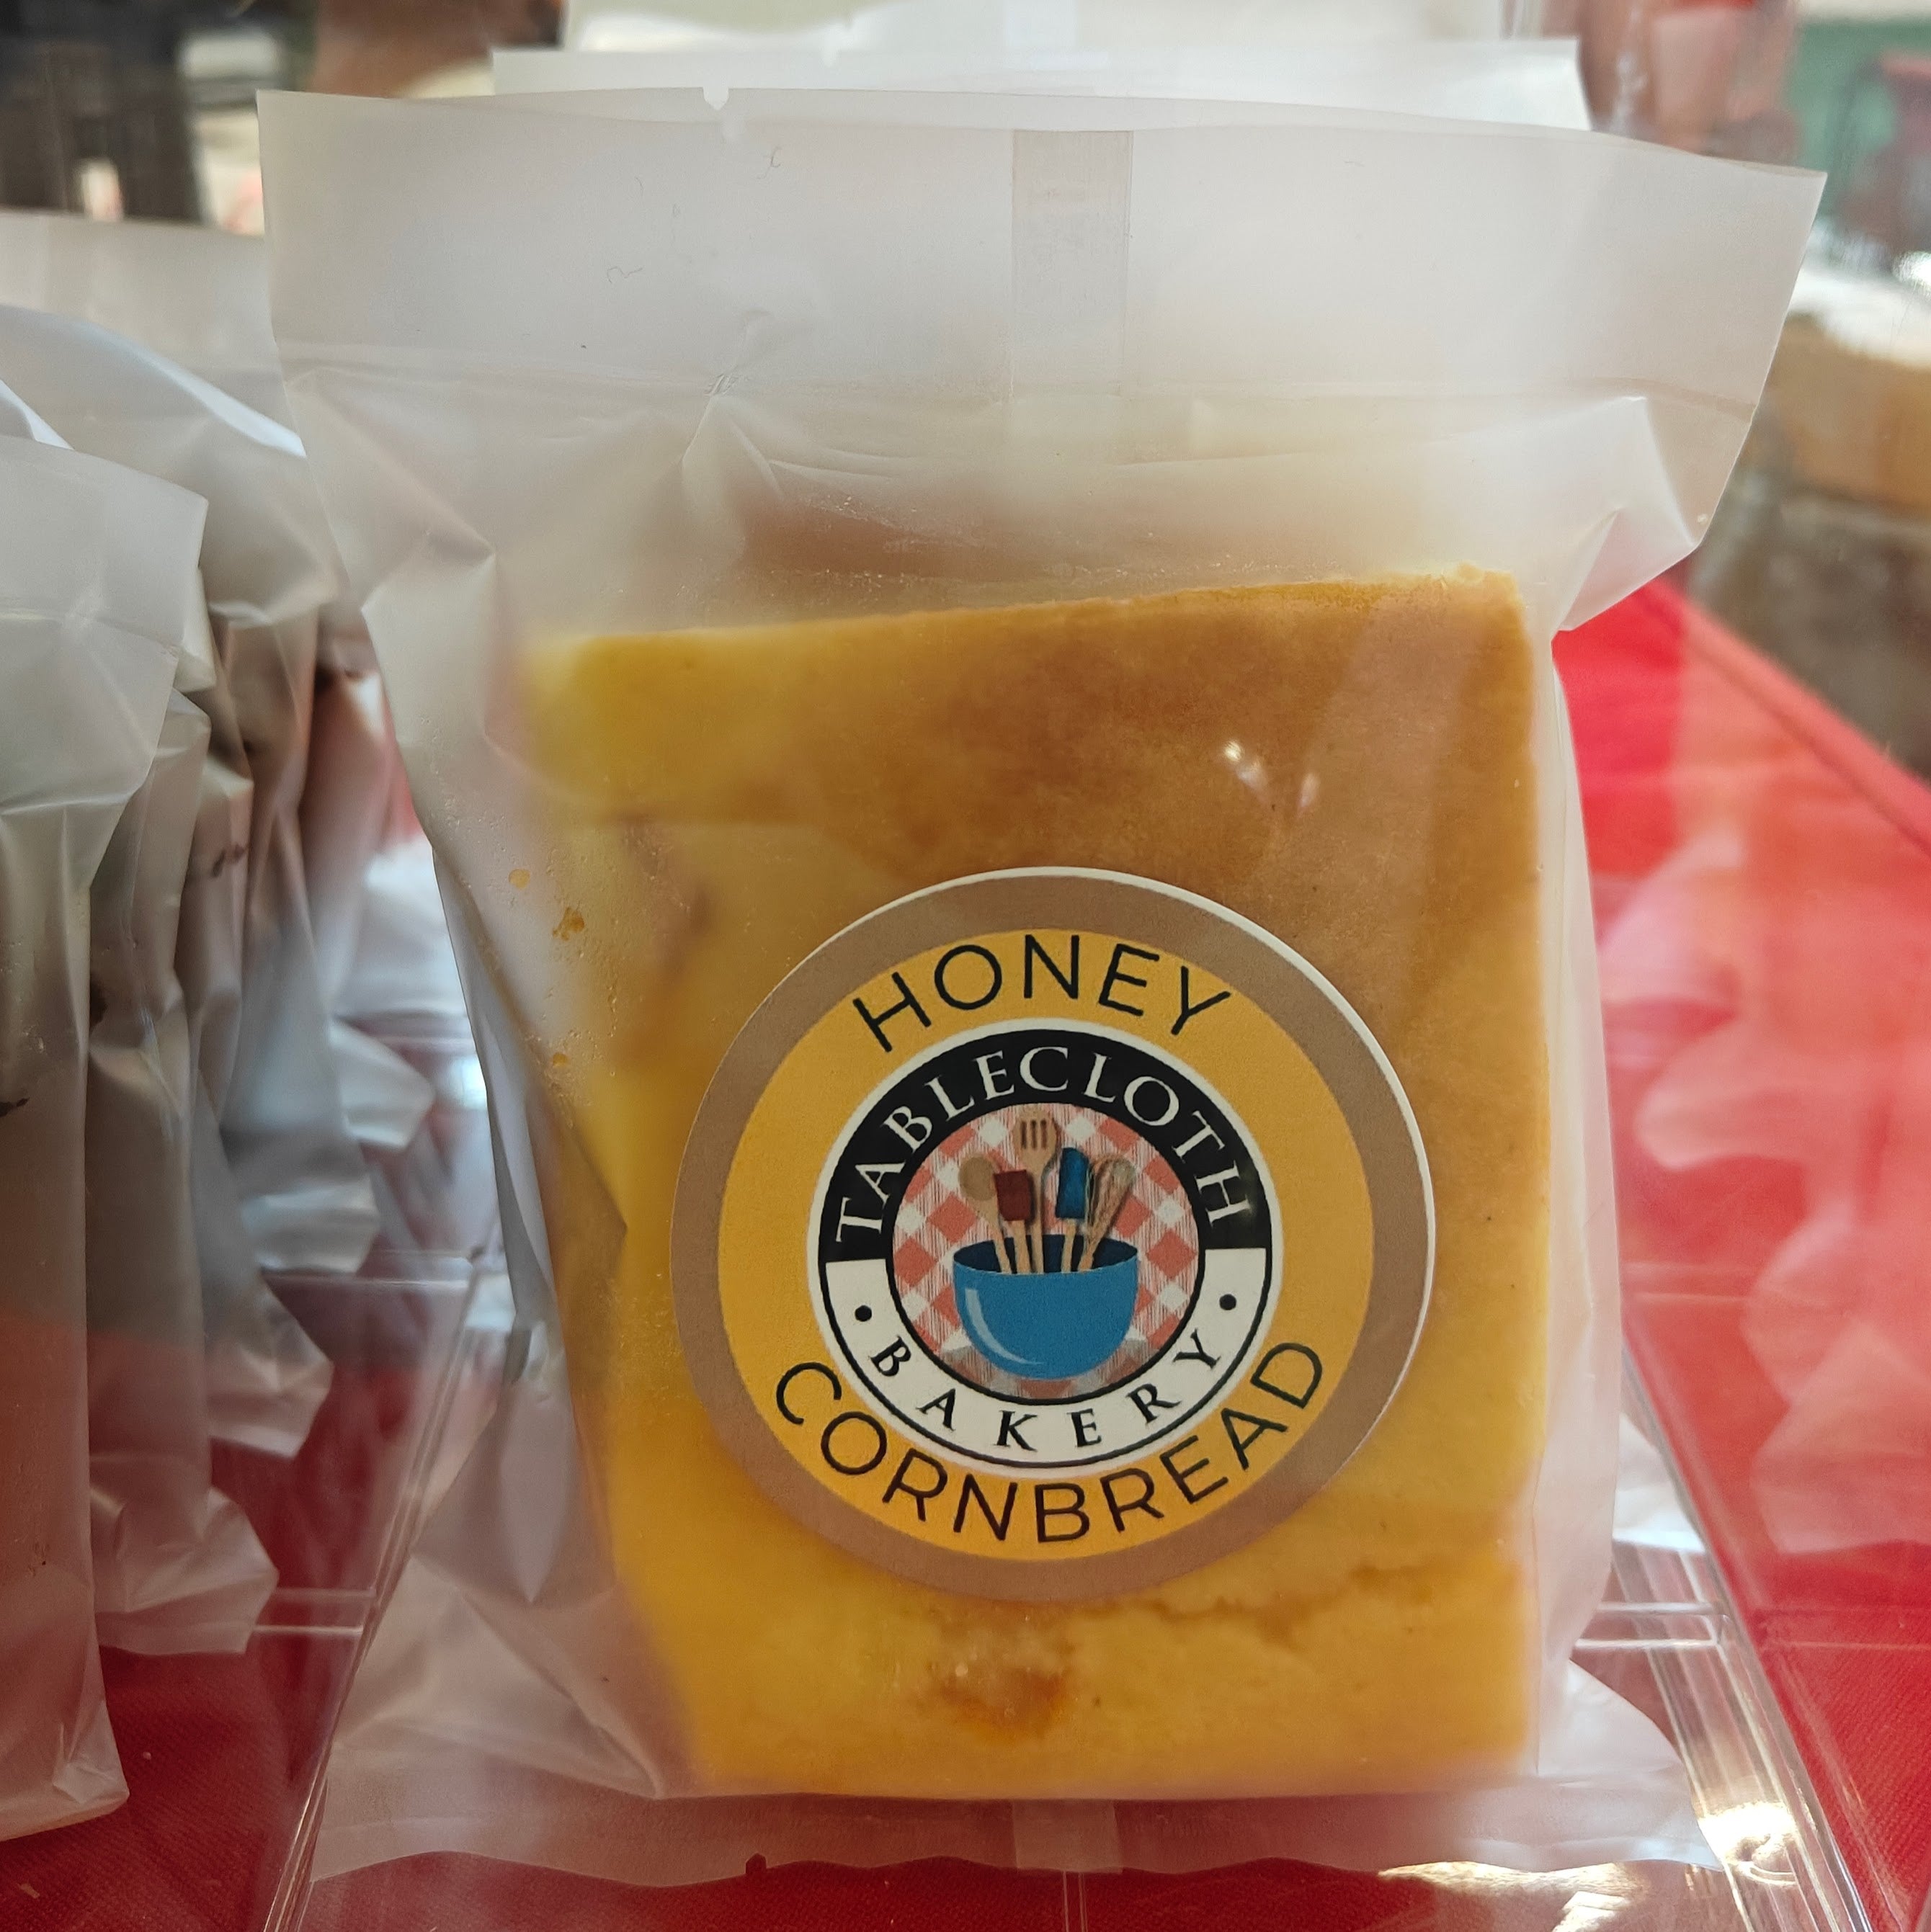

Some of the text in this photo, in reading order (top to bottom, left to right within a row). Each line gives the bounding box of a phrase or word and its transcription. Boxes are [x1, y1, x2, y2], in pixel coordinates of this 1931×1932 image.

[852, 934, 1231, 1053] HONEY
[835, 1046, 1253, 1243] TABLECLOTH
[775, 1341, 1324, 1544] CORNBREAD
[870, 1333, 1223, 1452] BAKERY
